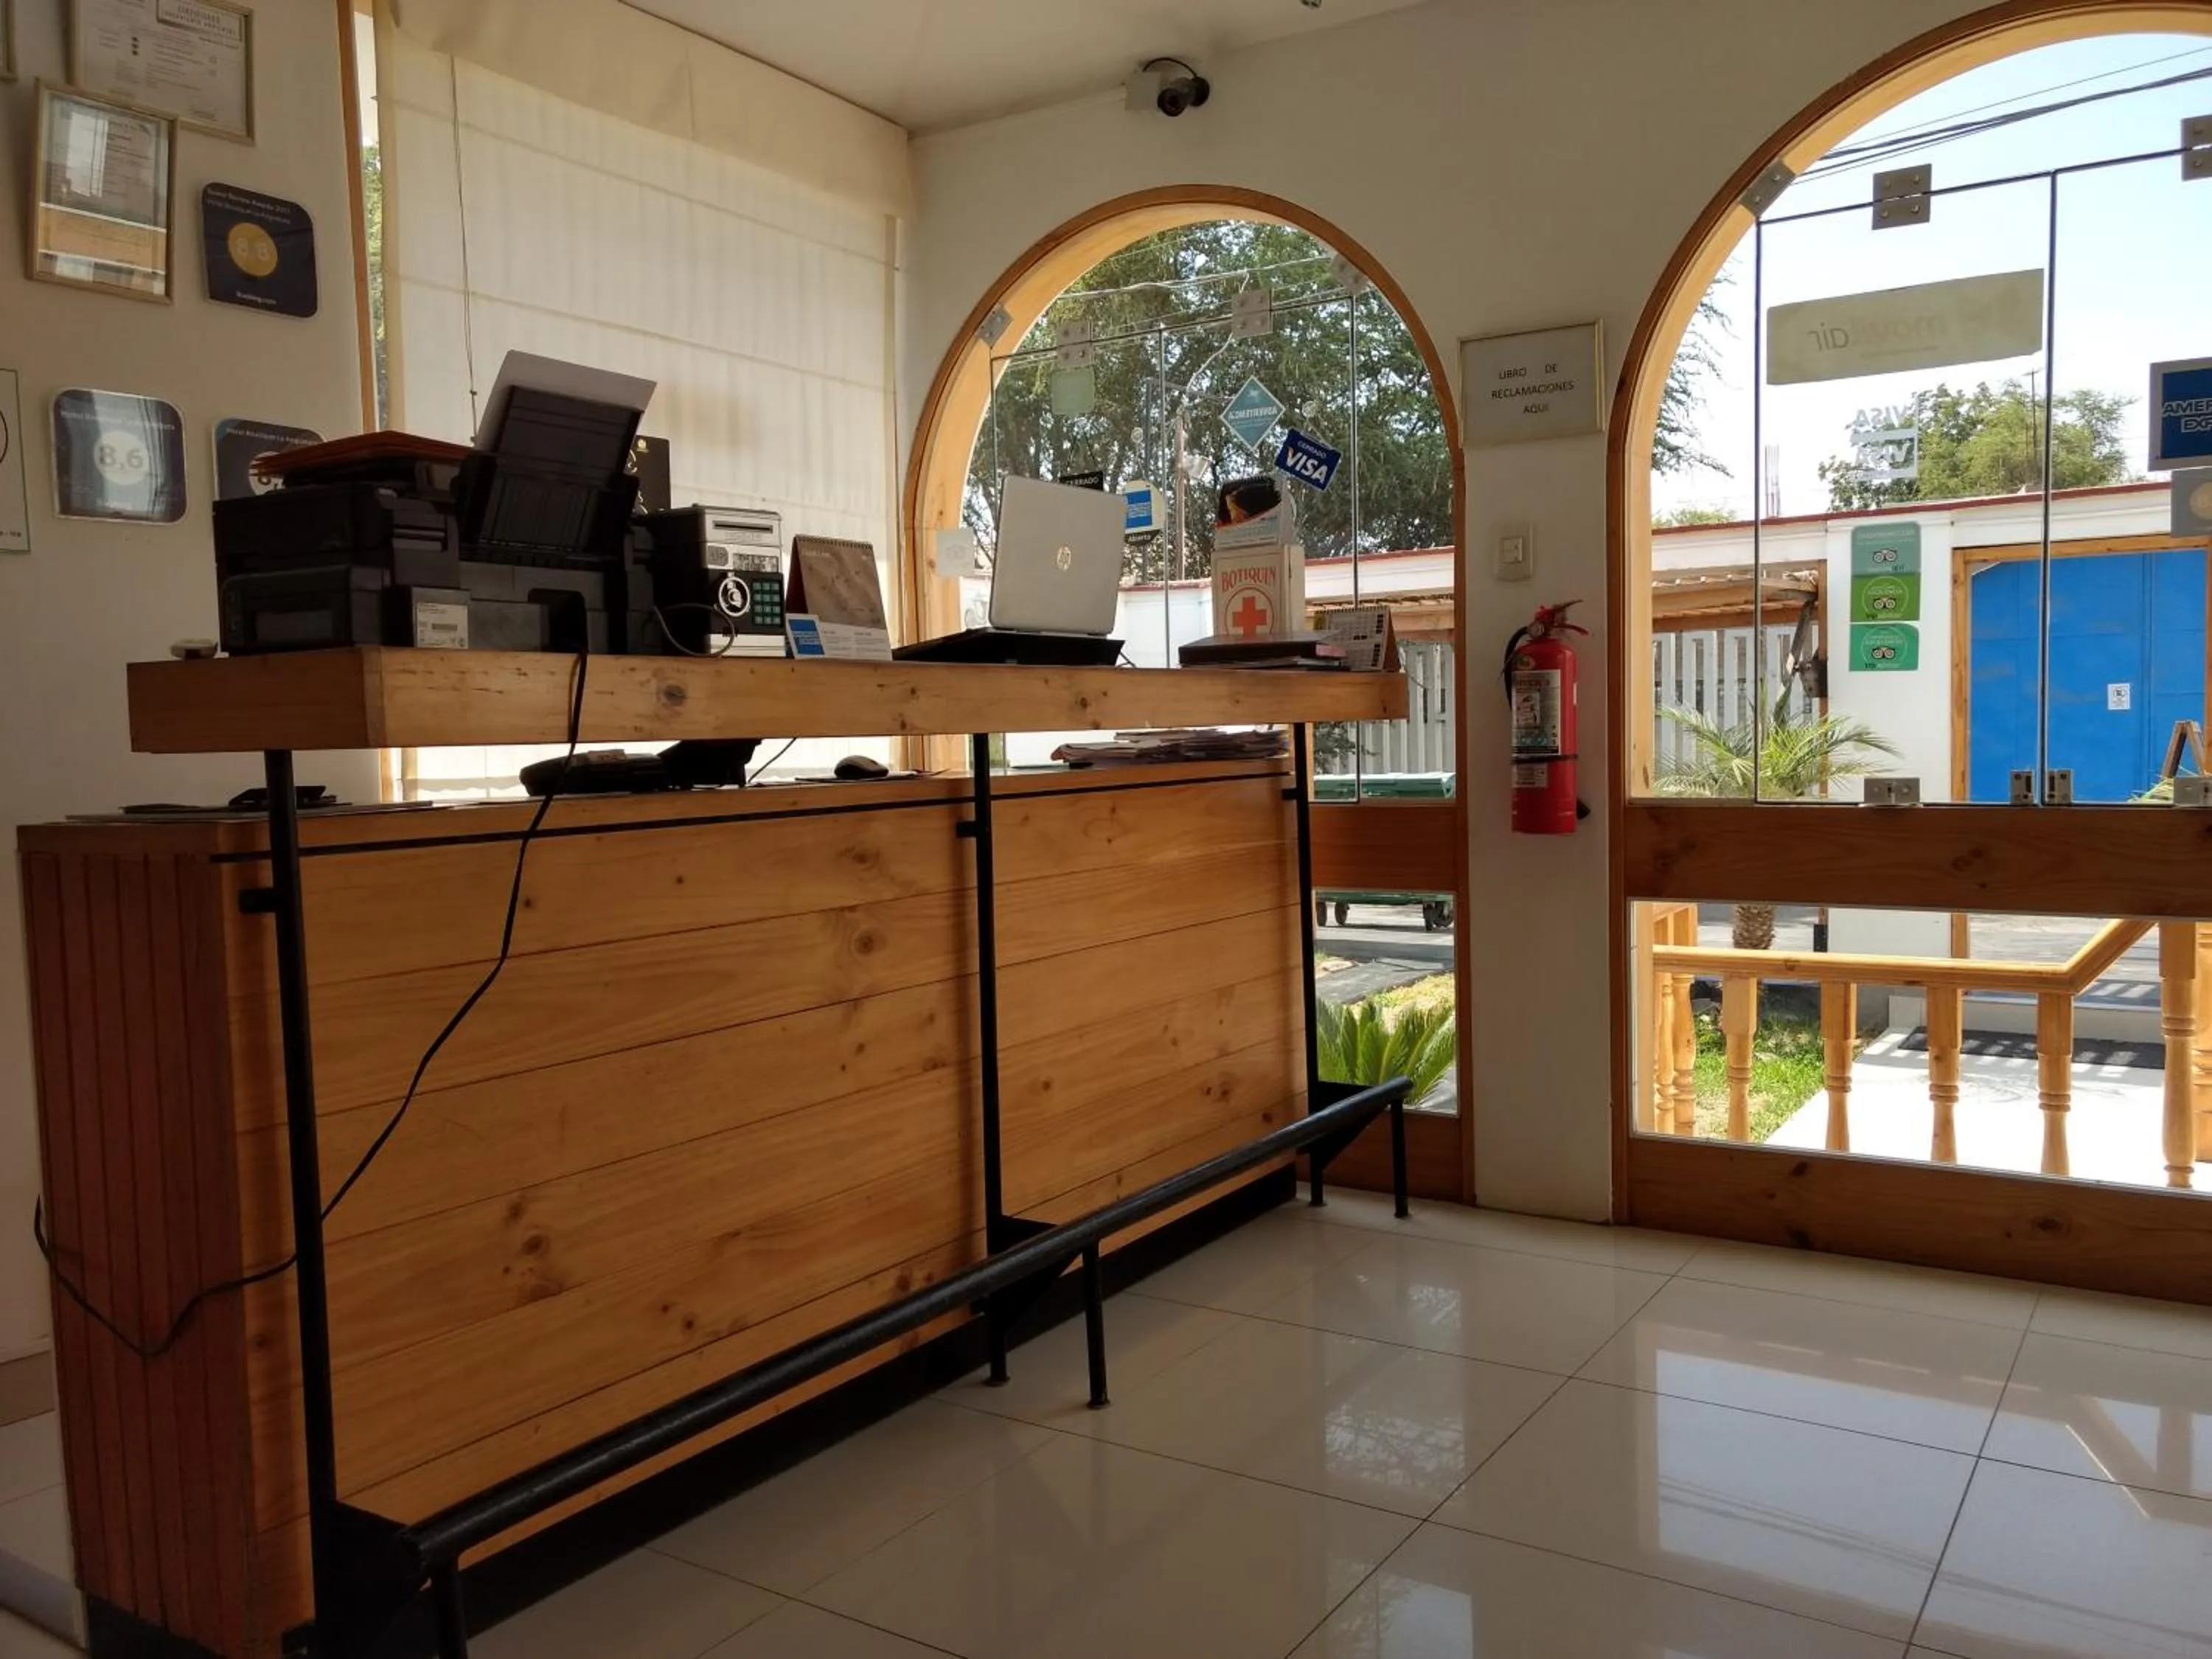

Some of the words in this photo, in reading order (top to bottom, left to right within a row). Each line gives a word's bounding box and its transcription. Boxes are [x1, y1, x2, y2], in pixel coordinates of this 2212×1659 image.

[1498, 368, 1527, 380] LIBRO
[1545, 364, 1558, 374] DE
[1492, 380, 1575, 400] RECLAMACIONES
[1297, 440, 1326, 459] CERRADO
[1286, 447, 1328, 484] VISA
[1221, 566, 1276, 593] BOTIQUIN
